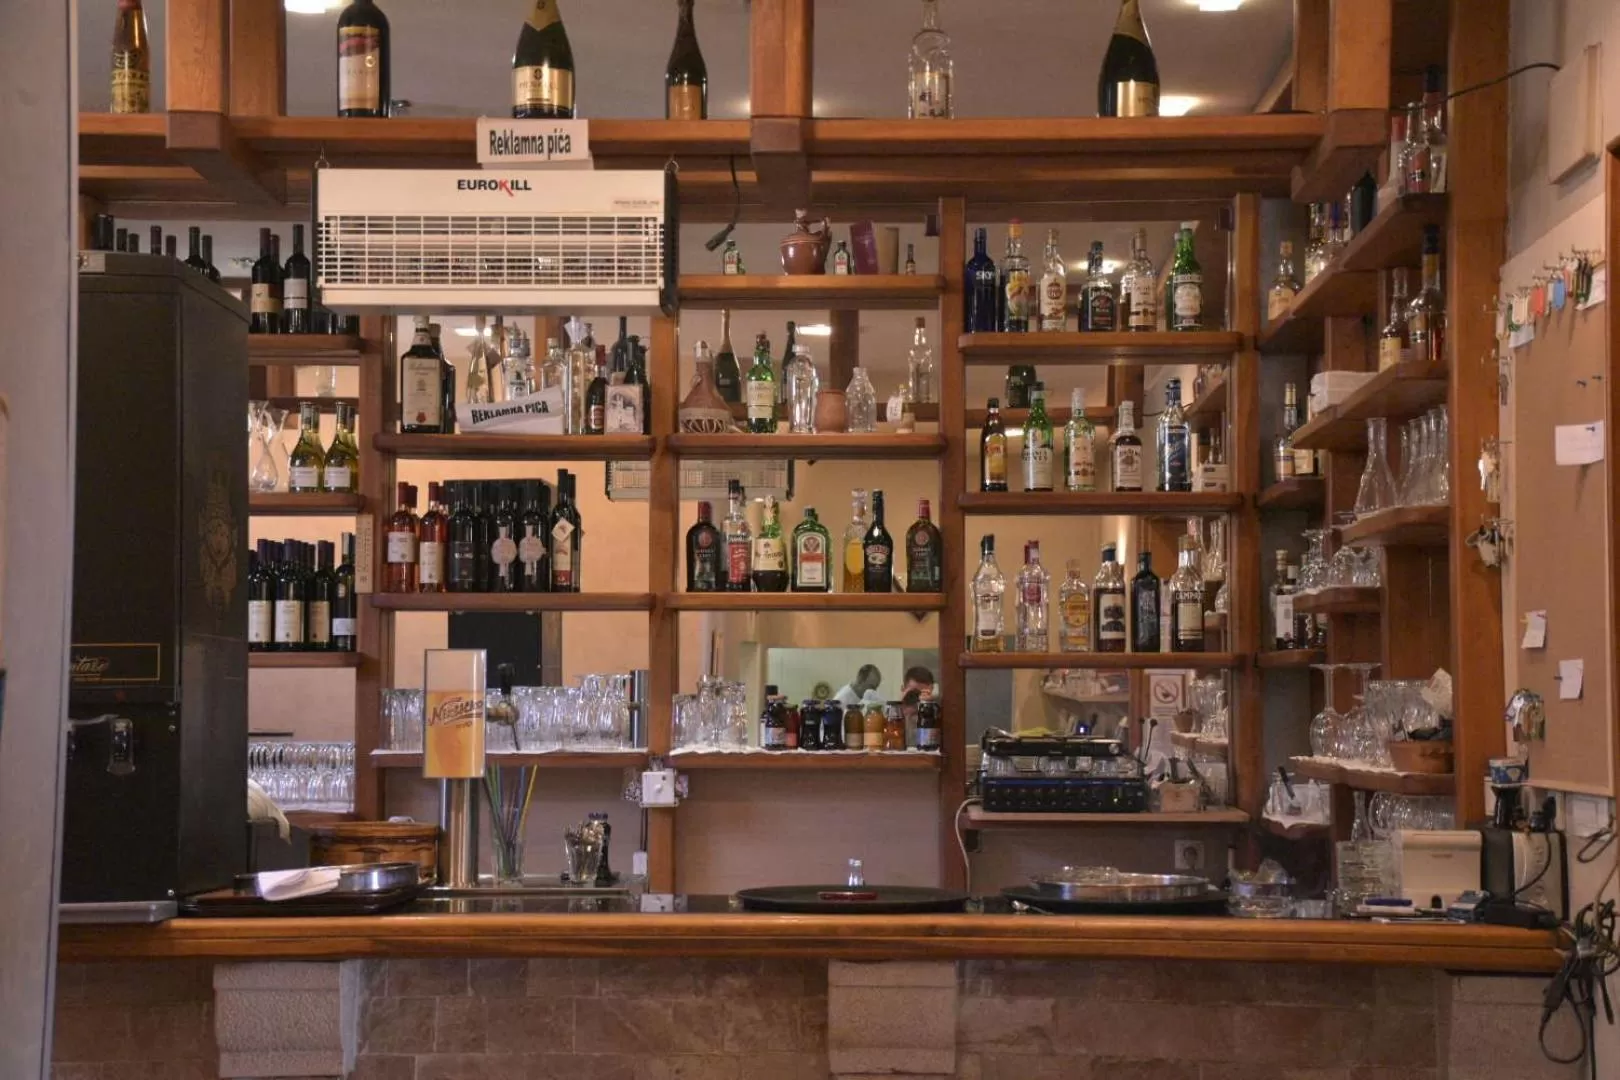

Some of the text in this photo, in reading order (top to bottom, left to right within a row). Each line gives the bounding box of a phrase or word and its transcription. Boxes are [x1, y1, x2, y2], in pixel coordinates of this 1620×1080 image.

[489, 128, 571, 160] Reklamna pića
[457, 179, 532, 197] EUROKILL
